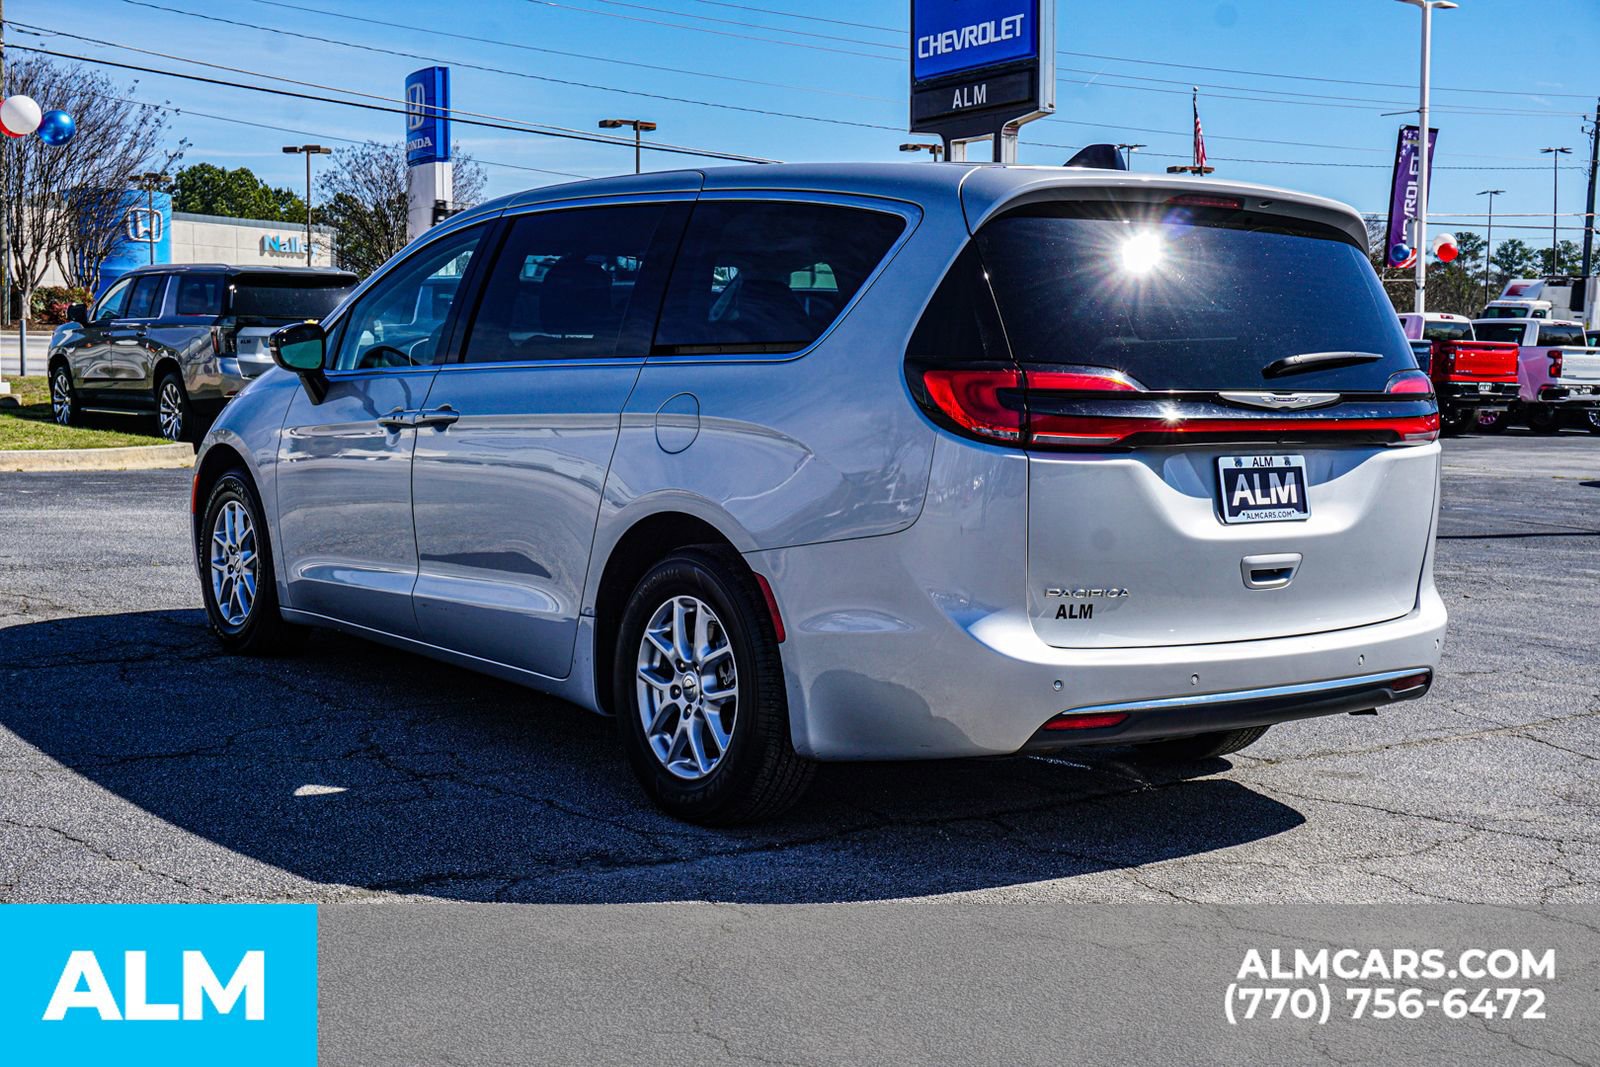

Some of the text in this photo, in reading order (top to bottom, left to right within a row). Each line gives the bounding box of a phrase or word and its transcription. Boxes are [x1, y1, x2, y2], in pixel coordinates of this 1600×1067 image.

[918, 13, 1024, 59] CHEVROLET
[952, 83, 987, 109] ALM
[1252, 456, 1274, 468] ALM
[1232, 472, 1298, 506] ALM
[1246, 511, 1293, 520] ALMCARS.COM
[1045, 588, 1129, 598] PACIFICA
[1055, 604, 1093, 620] ALM
